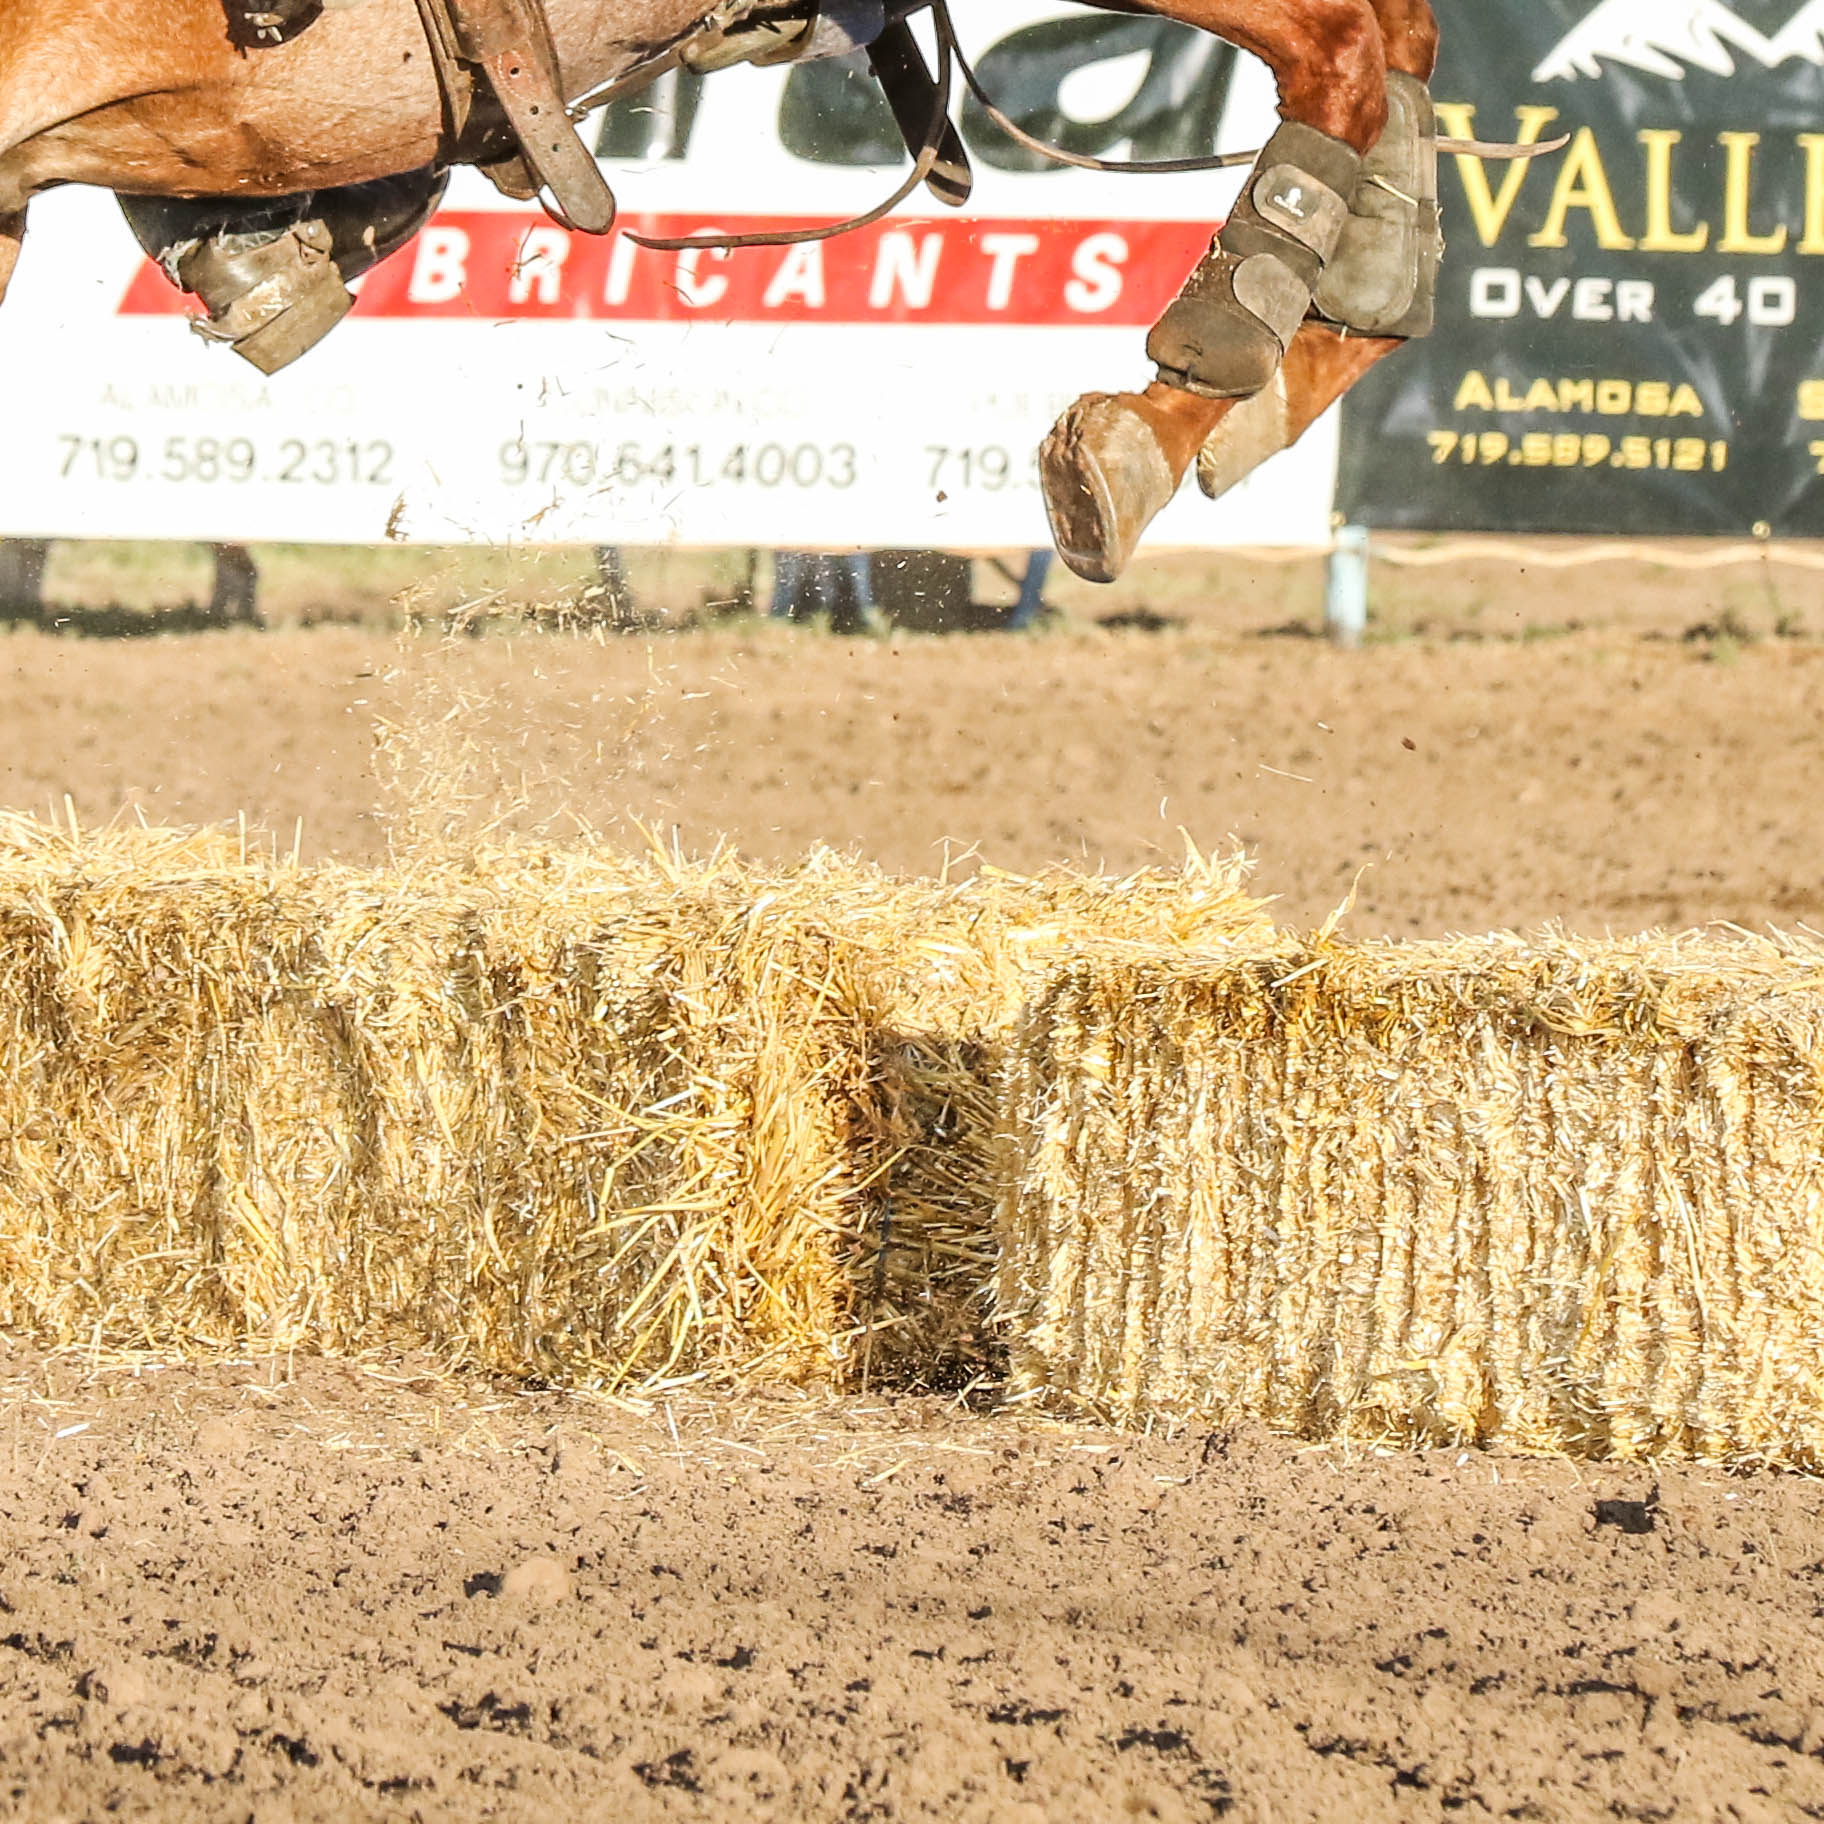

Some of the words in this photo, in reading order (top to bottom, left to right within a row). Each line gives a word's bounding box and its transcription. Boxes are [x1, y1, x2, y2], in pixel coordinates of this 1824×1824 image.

[344, 226, 1131, 312] BRICANTS
[1470, 267, 1656, 322] OVER
[1694, 275, 1796, 327] 40
[1453, 369, 1705, 417] ALAMOSA
[57, 433, 394, 485] 719.589.2312
